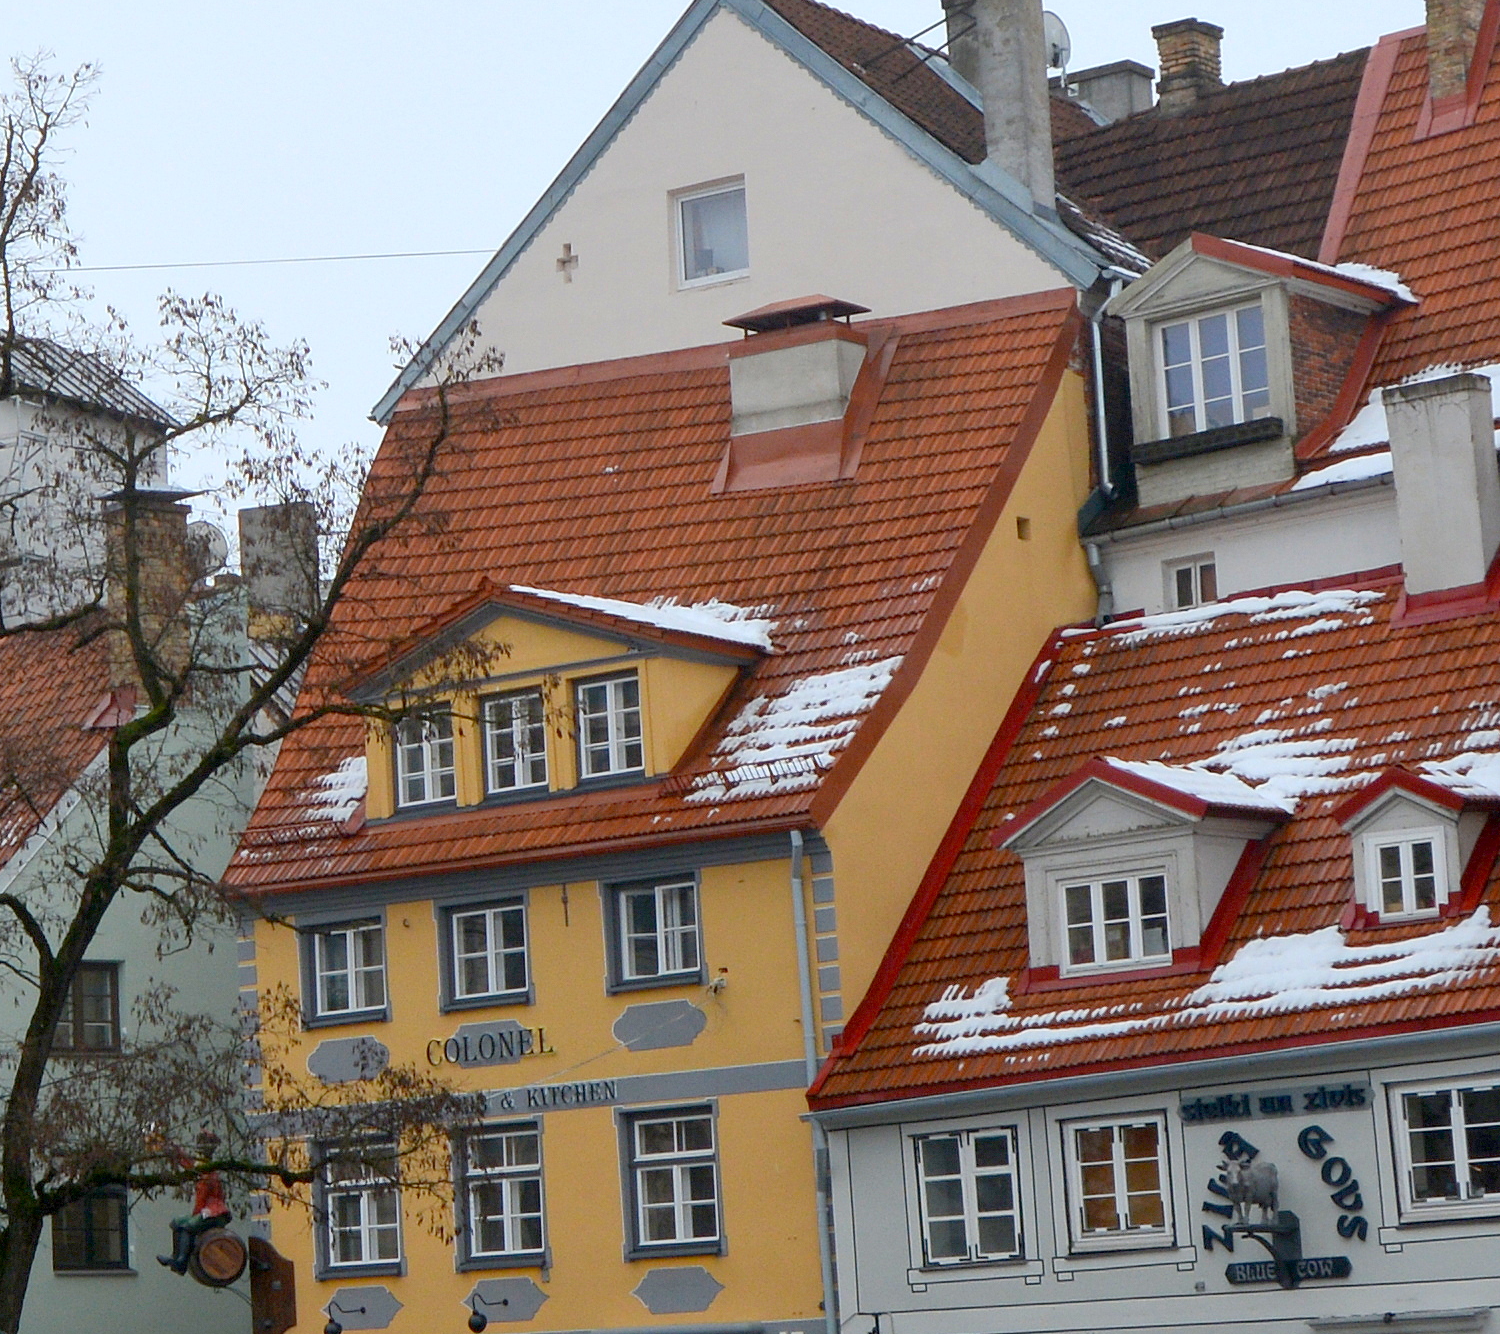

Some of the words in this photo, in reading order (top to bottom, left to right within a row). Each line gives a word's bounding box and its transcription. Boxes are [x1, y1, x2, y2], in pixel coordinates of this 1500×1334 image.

[426, 1027, 556, 1067] COLONEL
[501, 1091, 515, 1110] &
[526, 1080, 618, 1108] KITCHEN
[1235, 1261, 1277, 1282] BLUE
[1297, 1259, 1334, 1278] COW
